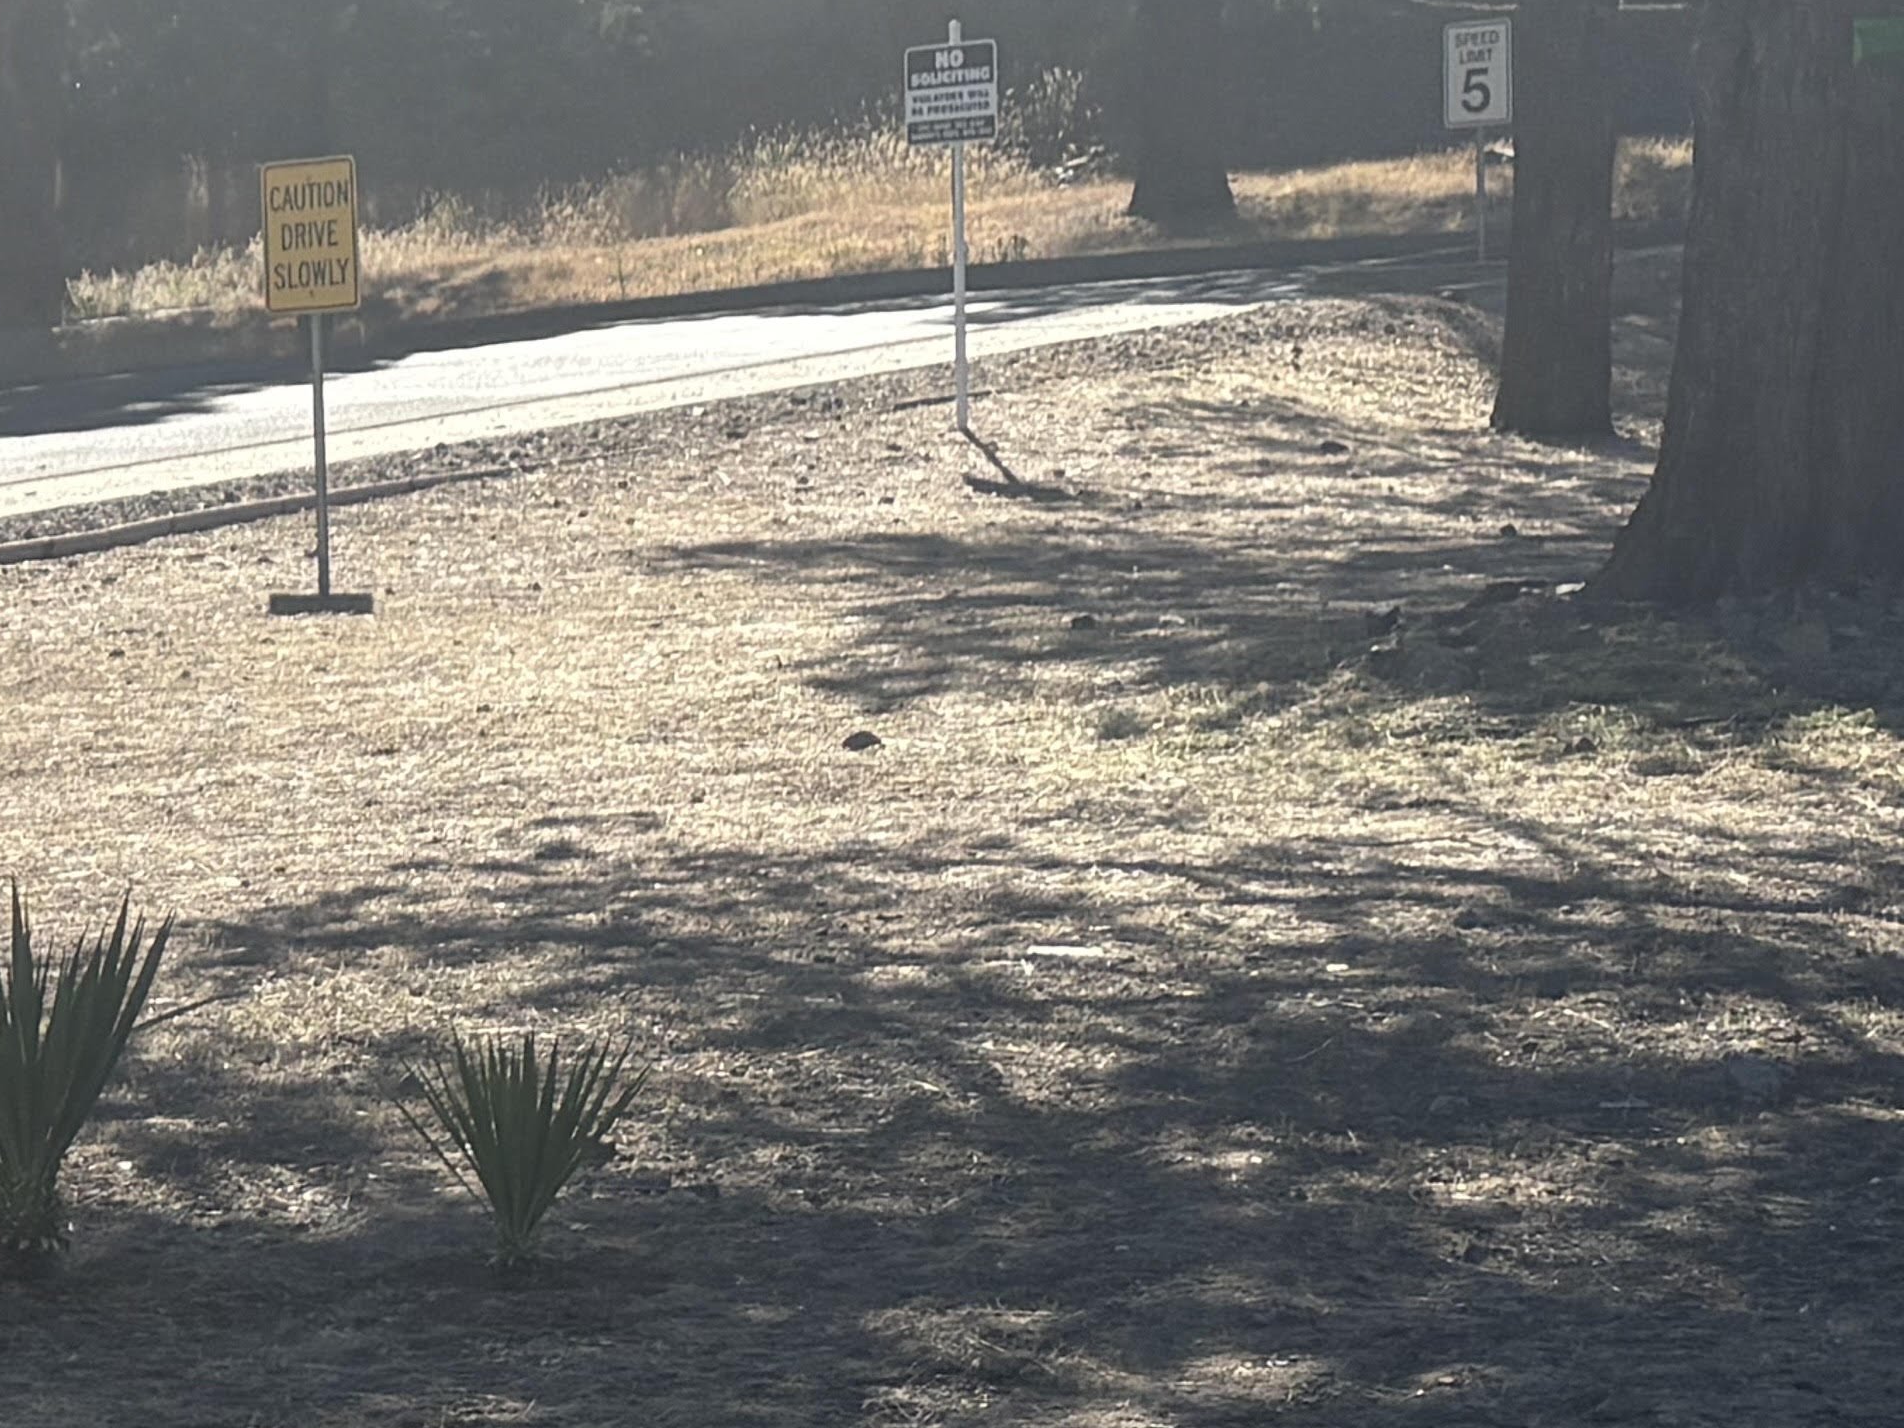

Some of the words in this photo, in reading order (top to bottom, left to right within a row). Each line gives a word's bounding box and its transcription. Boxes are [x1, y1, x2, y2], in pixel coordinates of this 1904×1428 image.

[1455, 30, 1500, 48] SPEED
[935, 49, 964, 69] NO
[1459, 48, 1492, 65] LIMIT
[910, 65, 991, 88] SOLICITING
[1460, 66, 1491, 113] 5
[269, 179, 349, 212] CAUTION
[280, 219, 339, 252] DRIVE
[273, 257, 350, 291] SLOWLY
